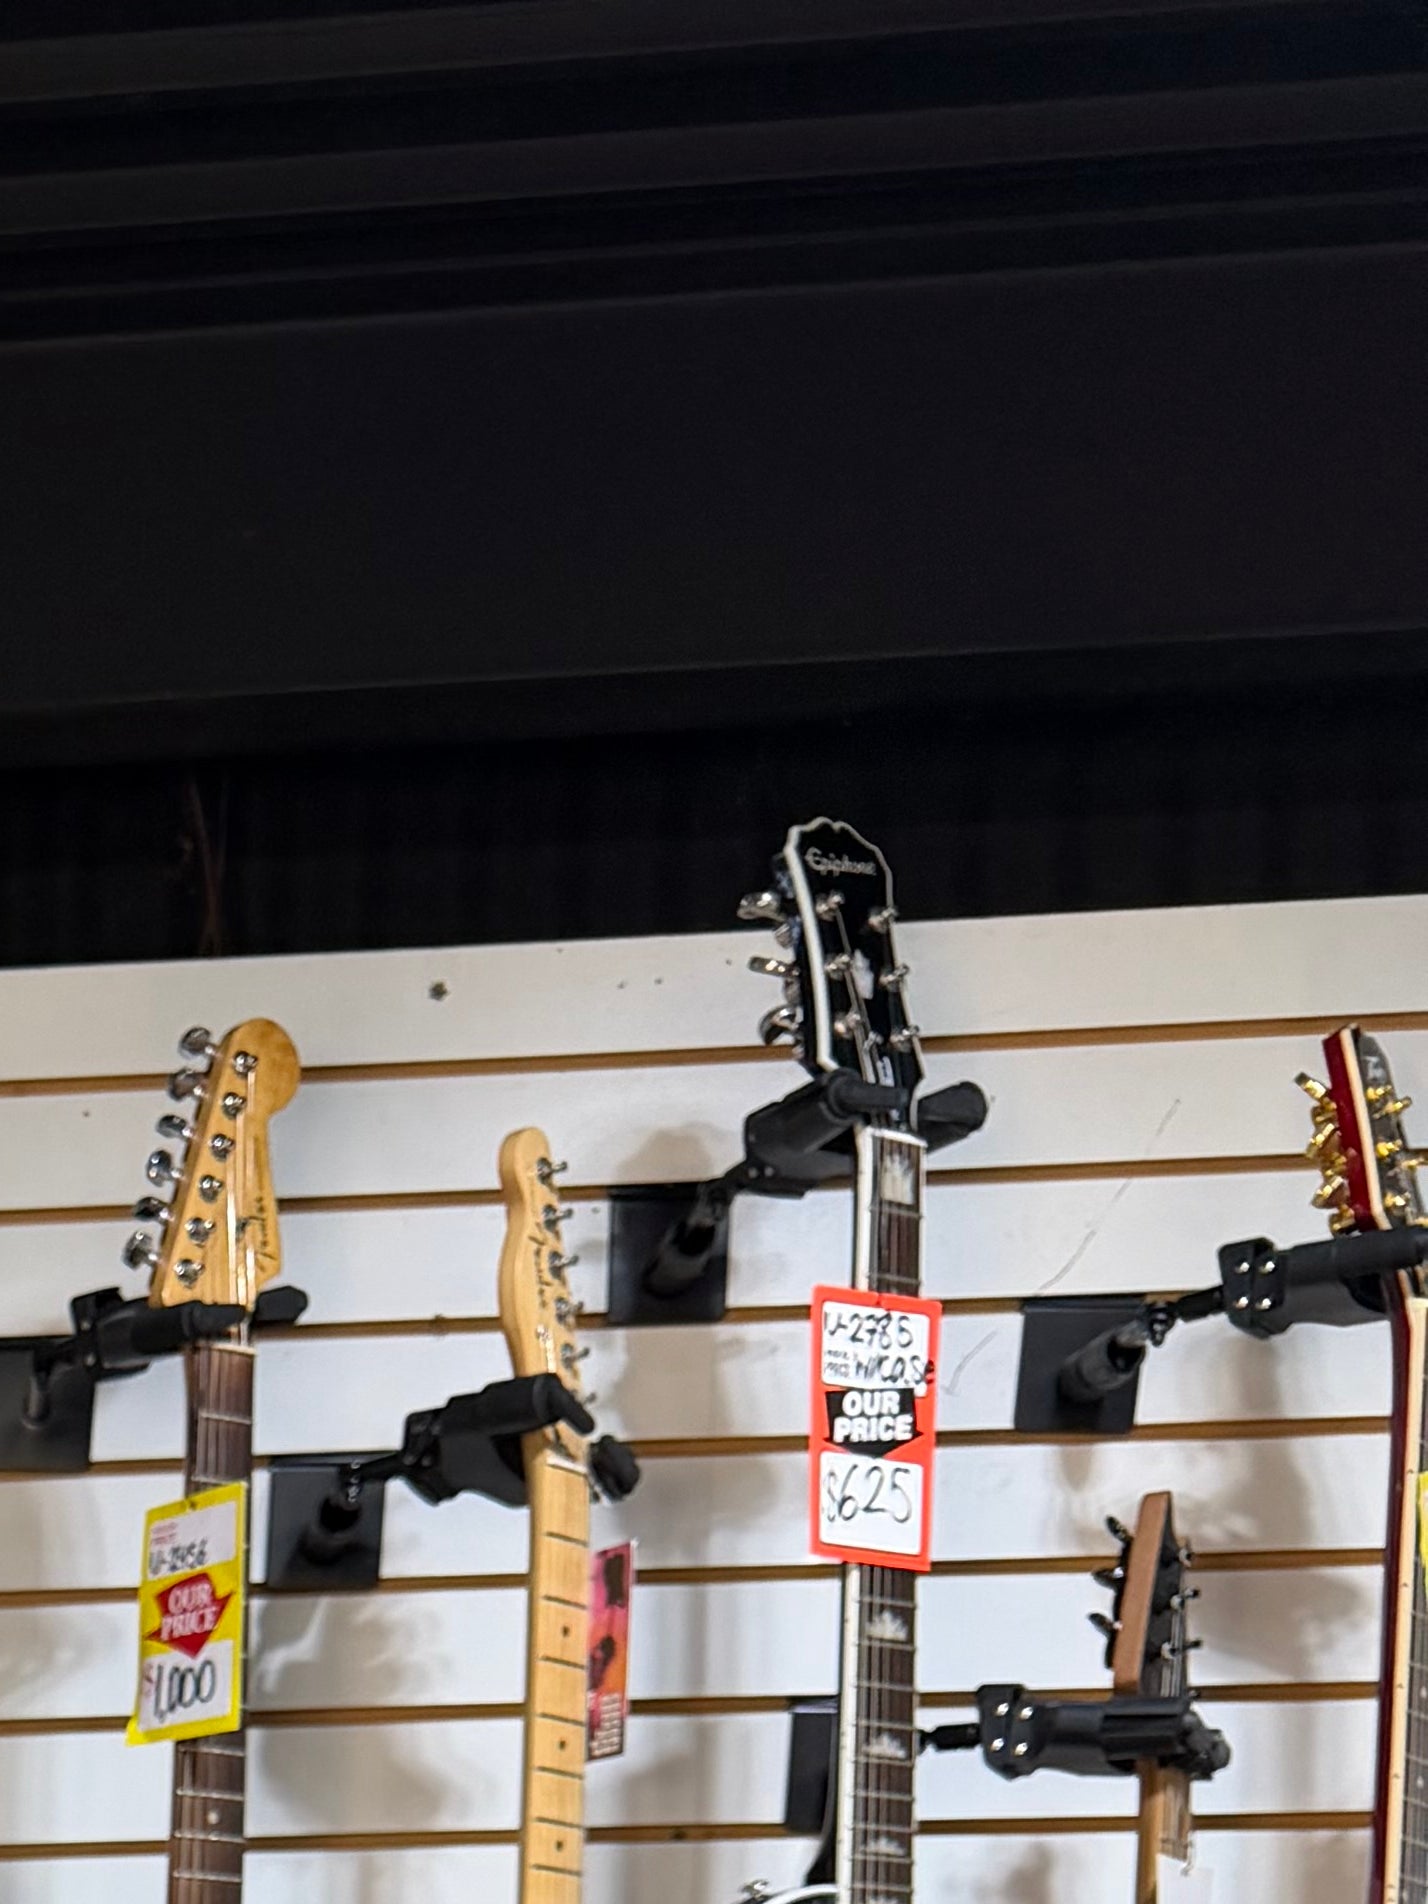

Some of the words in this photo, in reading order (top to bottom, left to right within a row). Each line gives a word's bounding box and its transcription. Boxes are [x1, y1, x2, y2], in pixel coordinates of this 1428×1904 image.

[842, 1389, 901, 1418] OUR
[833, 1413, 914, 1444] PRICE
[823, 1463, 912, 1524] $625
[167, 1581, 214, 1617] OUR
[159, 1604, 220, 1642] PRICE
